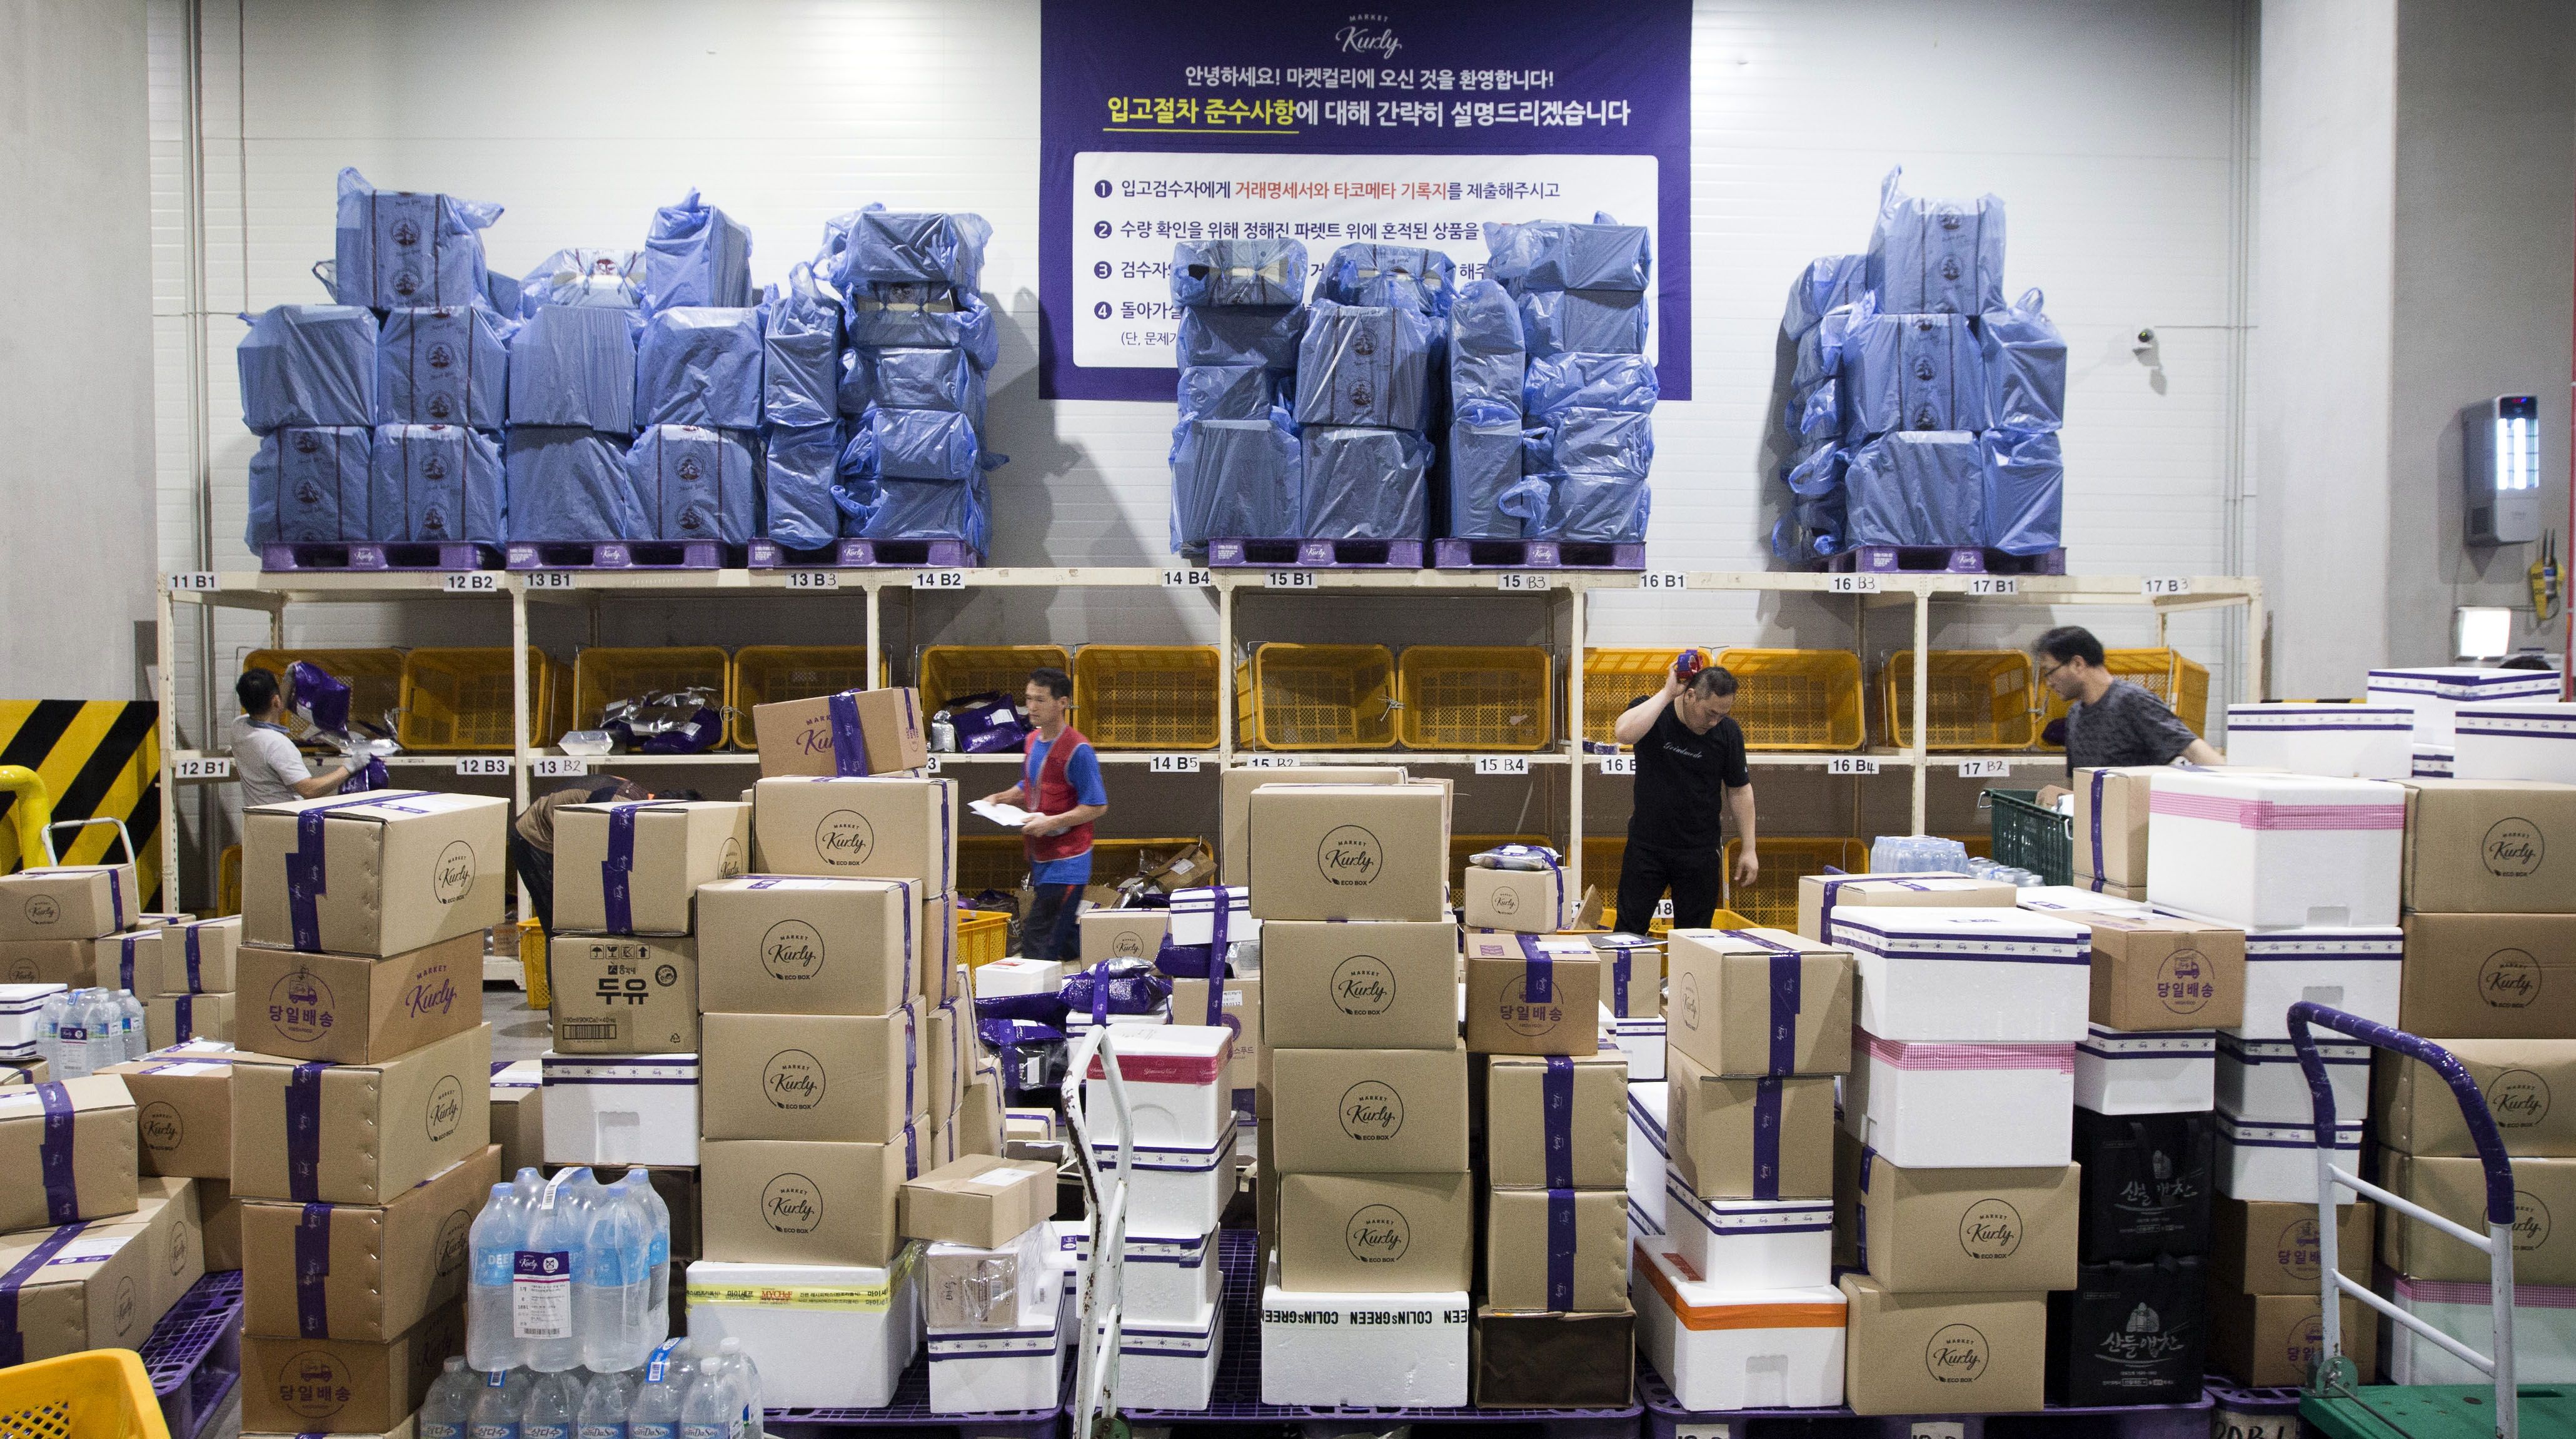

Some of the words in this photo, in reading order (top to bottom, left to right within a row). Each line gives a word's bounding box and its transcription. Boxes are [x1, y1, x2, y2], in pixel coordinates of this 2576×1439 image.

[1349, 14, 1388, 23] MARKET
[1336, 26, 1402, 60] Kurly
[1185, 66, 1280, 86] 안녕하세요!
[1287, 68, 1374, 88] 마켓컬리에
[1379, 69, 1414, 89] 오신
[1420, 69, 1455, 89] 것을
[1459, 69, 1554, 91] 환영합니다!
[1109, 97, 1199, 124] 입고절차
[1204, 99, 1317, 125] 준수사항에
[1326, 100, 1369, 126] 대해
[1376, 101, 1442, 126] 간략히
[1451, 99, 1631, 127] 설명드리겠습니다
[1122, 179, 1231, 199] 입고검수자에게
[1235, 181, 1329, 199] 거래명세서와
[1334, 181, 1397, 199] 타코메타
[1401, 181, 1462, 201] 기록지를
[1467, 181, 1561, 201] 제출해주시고
[1120, 221, 1152, 239] 수량
[1156, 221, 1202, 239] 확인을
[1207, 222, 1239, 239] 위해
[1243, 222, 1289, 239] 정해진
[1294, 223, 1342, 240] 파렛트
[1346, 223, 1376, 240] 위에
[1382, 223, 1427, 240] 혼적된
[1433, 223, 1479, 240] 상품을
[1120, 261, 1173, 279] 검수자
[173, 575, 188, 588] 11
[195, 575, 215, 588] B1
[449, 576, 466, 588] 12
[472, 576, 493, 588] B2
[528, 573, 545, 586] 13
[551, 573, 570, 586] B1
[791, 573, 808, 586] 13
[814, 573, 837, 586] B3
[917, 573, 934, 586] 14
[941, 573, 961, 586] B2
[1165, 572, 1182, 584] 14
[1189, 572, 1210, 585] B4
[1270, 573, 1287, 585] 15
[1294, 573, 1312, 585] B1
[1503, 575, 1520, 587] 15
[1527, 576, 1546, 588] B3
[1641, 575, 1658, 587] 16
[1665, 575, 1684, 587] B1
[1834, 578, 1851, 590] 16
[1858, 576, 1874, 589] B3
[1973, 580, 1990, 593] 17
[1996, 580, 2013, 593] B1
[807, 715, 831, 725] MARK
[181, 762, 198, 775] 12
[205, 762, 223, 774] B1
[461, 760, 478, 772] 12
[485, 760, 505, 772] B3
[540, 761, 556, 774] 13
[564, 759, 581, 772] B2
[1153, 757, 1170, 769] 14
[1177, 757, 1197, 769] B5
[1606, 759, 1623, 770] 16
[1833, 759, 1849, 771] 16
[1856, 759, 1874, 773] B4
[1965, 763, 1980, 775] 17
[1988, 761, 2005, 771] B2
[822, 832, 865, 854] Kurly
[2490, 841, 2535, 864] Kurly
[1326, 850, 1374, 872] Kurly
[439, 865, 470, 887] Kurly
[768, 944, 815, 966] Kurly
[1116, 942, 1139, 954] Kurly
[417, 966, 446, 979] MARKET
[596, 979, 648, 1004] 두유
[1338, 980, 1386, 1002] Kurly
[2157, 982, 2213, 998] 당일배송
[2487, 972, 2532, 996] Kurly
[405, 978, 456, 1017] Kurly
[269, 1006, 334, 1027] 당일배송
[1501, 1006, 1562, 1021] 당일배송
[770, 1074, 817, 1096] Kurly
[430, 1099, 458, 1126] Kurly
[2493, 1094, 2542, 1115] Kurly
[1347, 1105, 1395, 1127] Kurly
[768, 1197, 814, 1221] Kurly
[1354, 1228, 1401, 1250] Kurly
[1966, 1224, 2013, 1246] Kurly
[1933, 1348, 1980, 1370] Kurly
[279, 1386, 351, 1401] 당일배송
